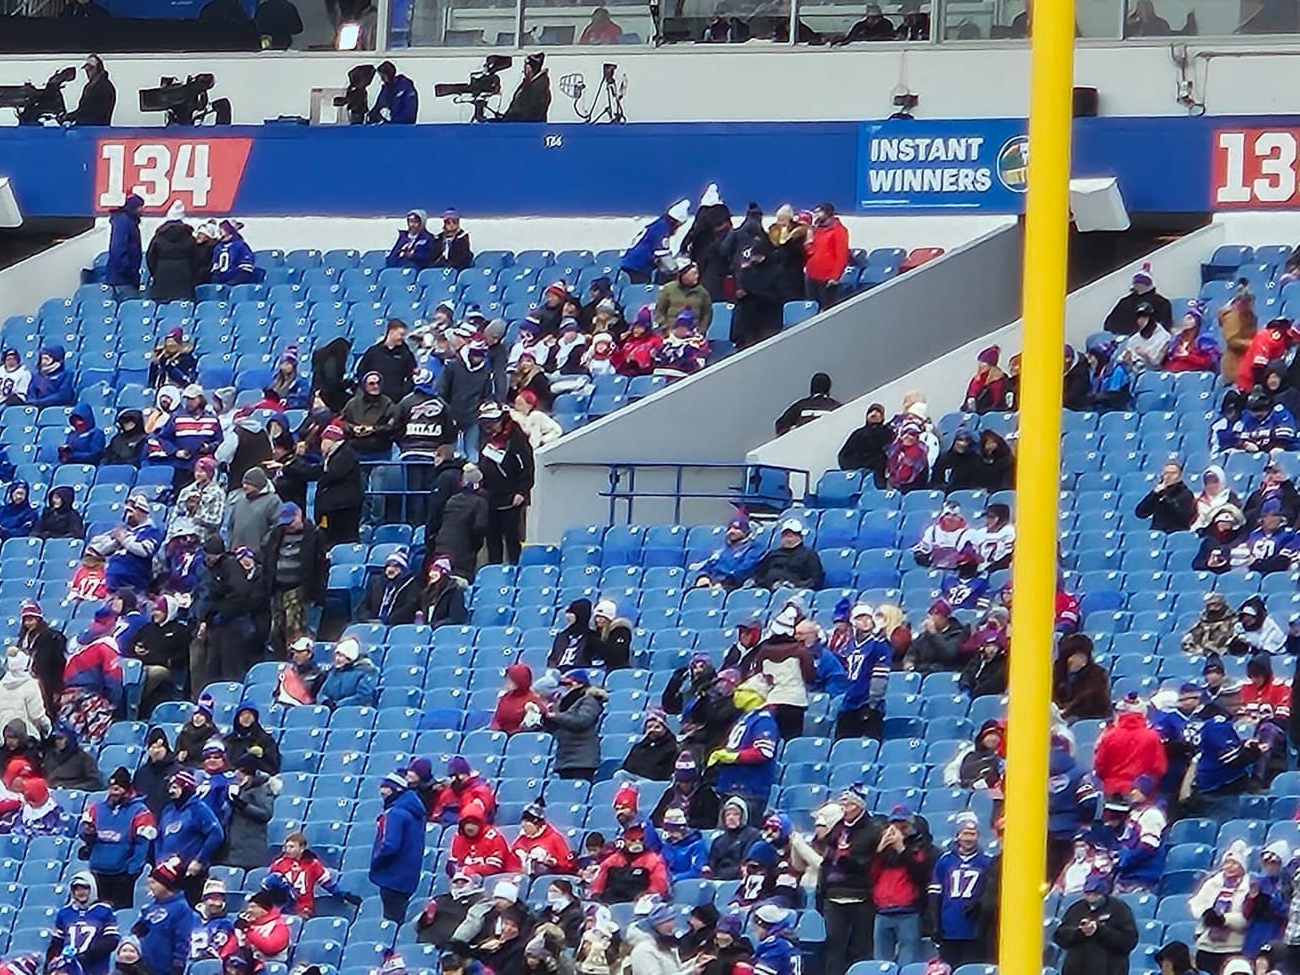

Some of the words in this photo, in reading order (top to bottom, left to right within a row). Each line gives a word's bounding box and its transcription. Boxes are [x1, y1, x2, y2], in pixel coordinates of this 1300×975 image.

[870, 137, 984, 162] INSTANT
[98, 143, 213, 208] 134
[869, 167, 993, 193] WINNERS
[1216, 131, 1300, 203] 13
[285, 870, 308, 896] 14
[950, 868, 980, 898] 17
[67, 923, 97, 953] 17
